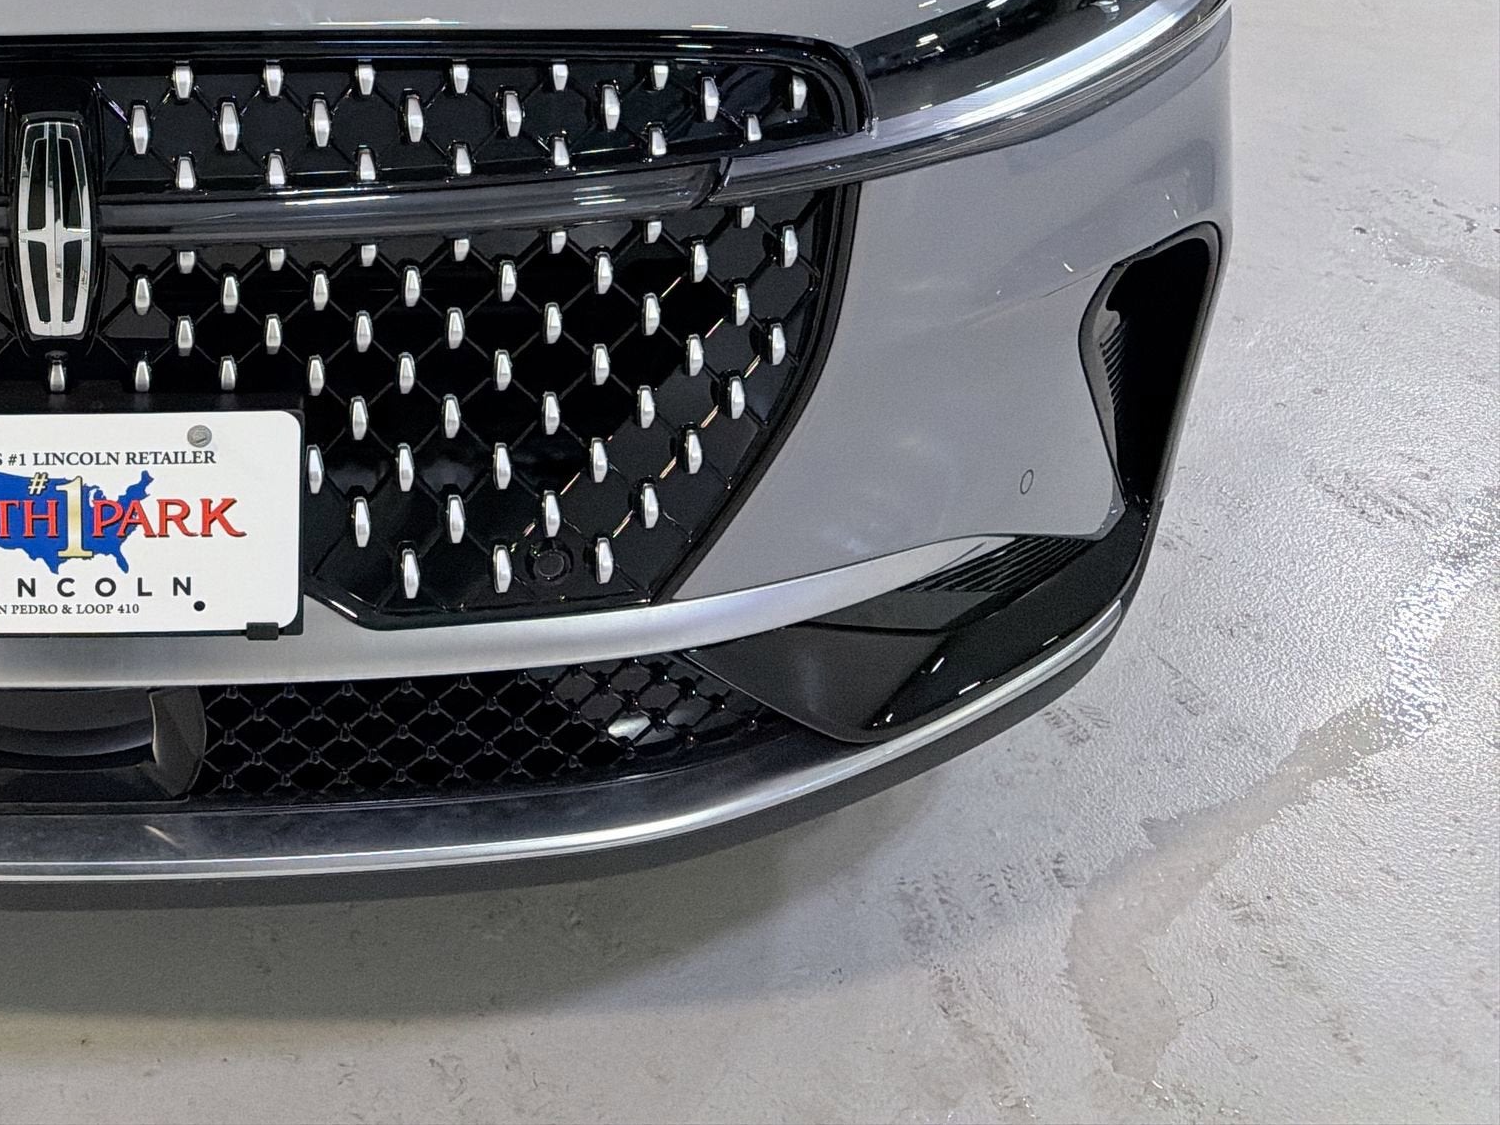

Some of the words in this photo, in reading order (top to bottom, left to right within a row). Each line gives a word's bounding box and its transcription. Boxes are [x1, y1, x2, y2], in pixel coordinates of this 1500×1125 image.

[7, 451, 27, 467] #1
[32, 451, 121, 467] LINCOLN
[124, 450, 217, 466] RETAILER
[91, 497, 248, 540] PARK
[11, 604, 59, 616] PEDRO
[61, 604, 73, 616] &
[76, 604, 114, 616] LOOP
[117, 604, 141, 616] 410
